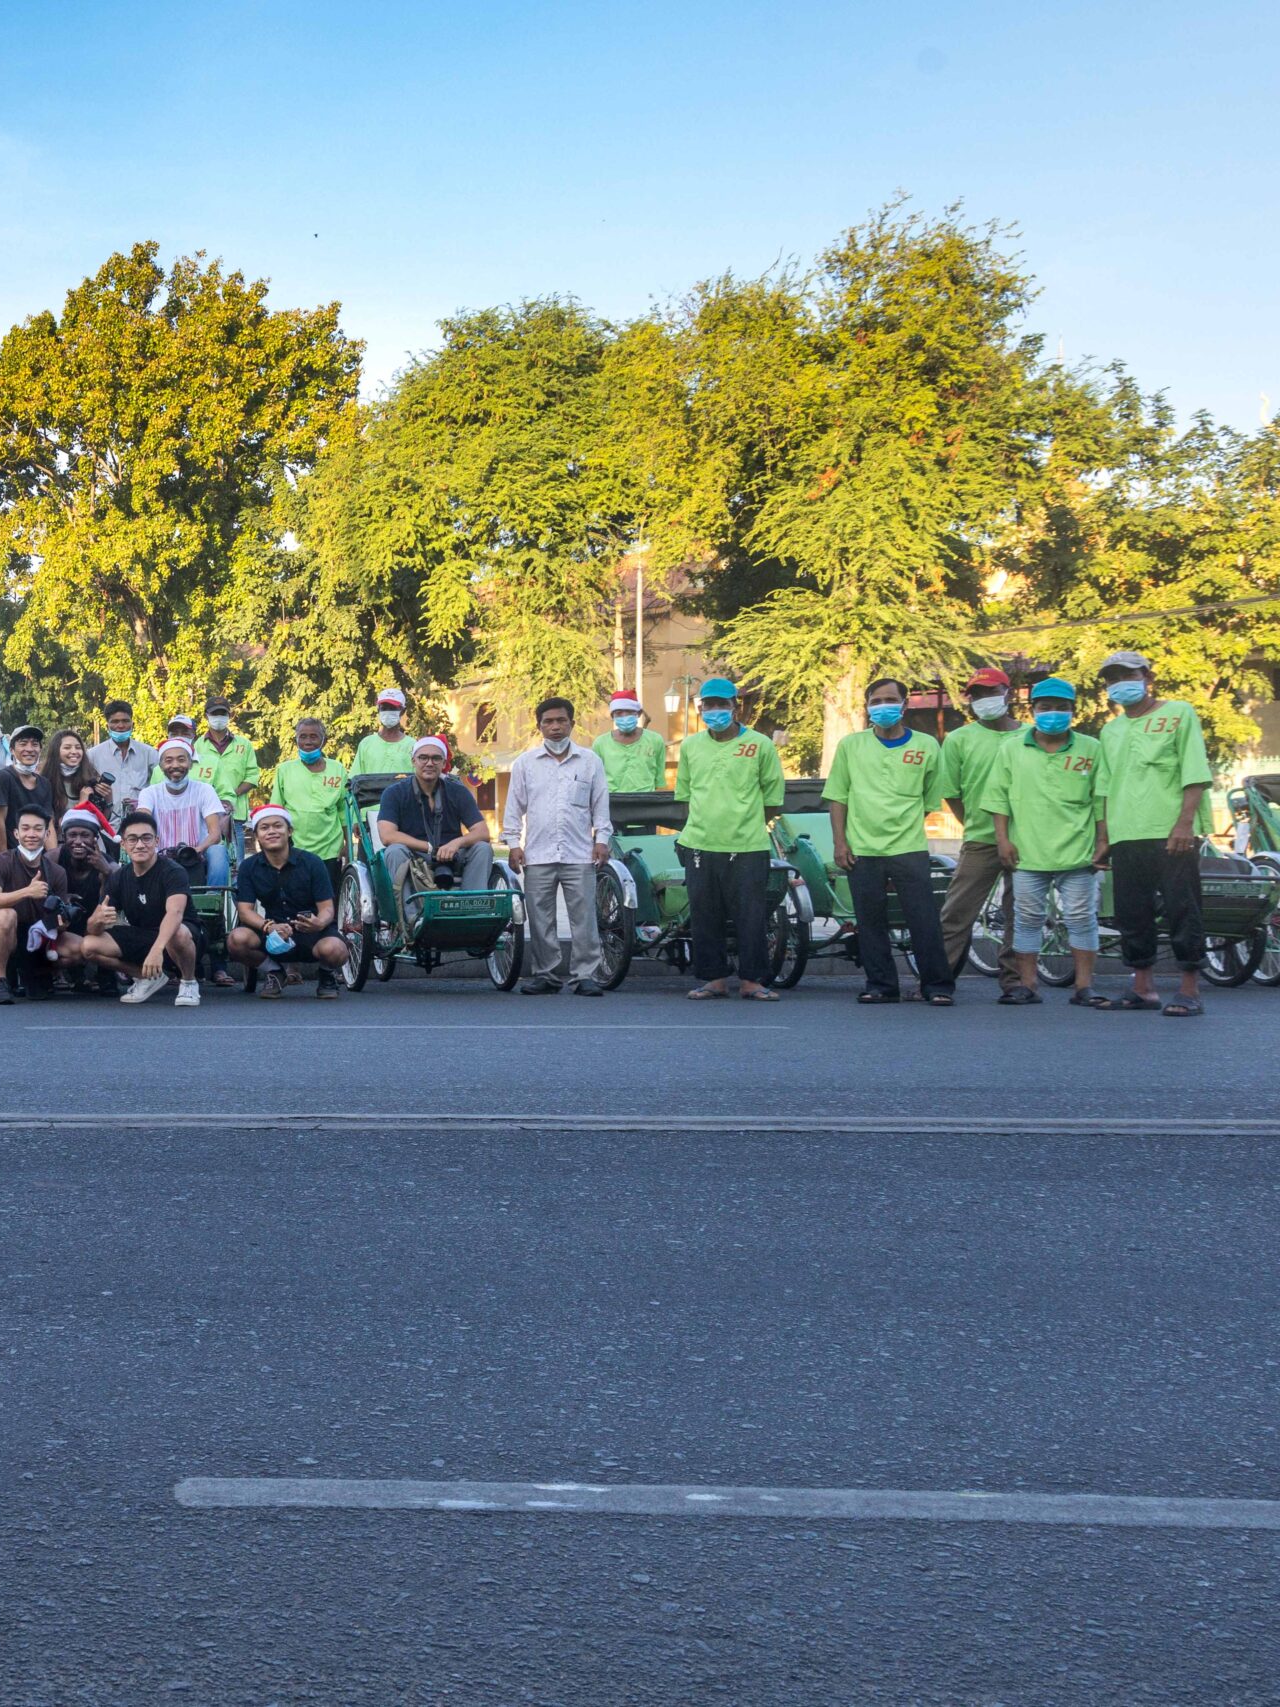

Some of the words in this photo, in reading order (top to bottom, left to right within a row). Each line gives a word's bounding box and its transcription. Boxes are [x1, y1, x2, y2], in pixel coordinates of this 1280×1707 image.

[1144, 717, 1181, 733] 133
[733, 744, 757, 757] 38
[902, 750, 925, 765] 65
[198, 768, 212, 778] 15
[323, 776, 341, 788] 142
